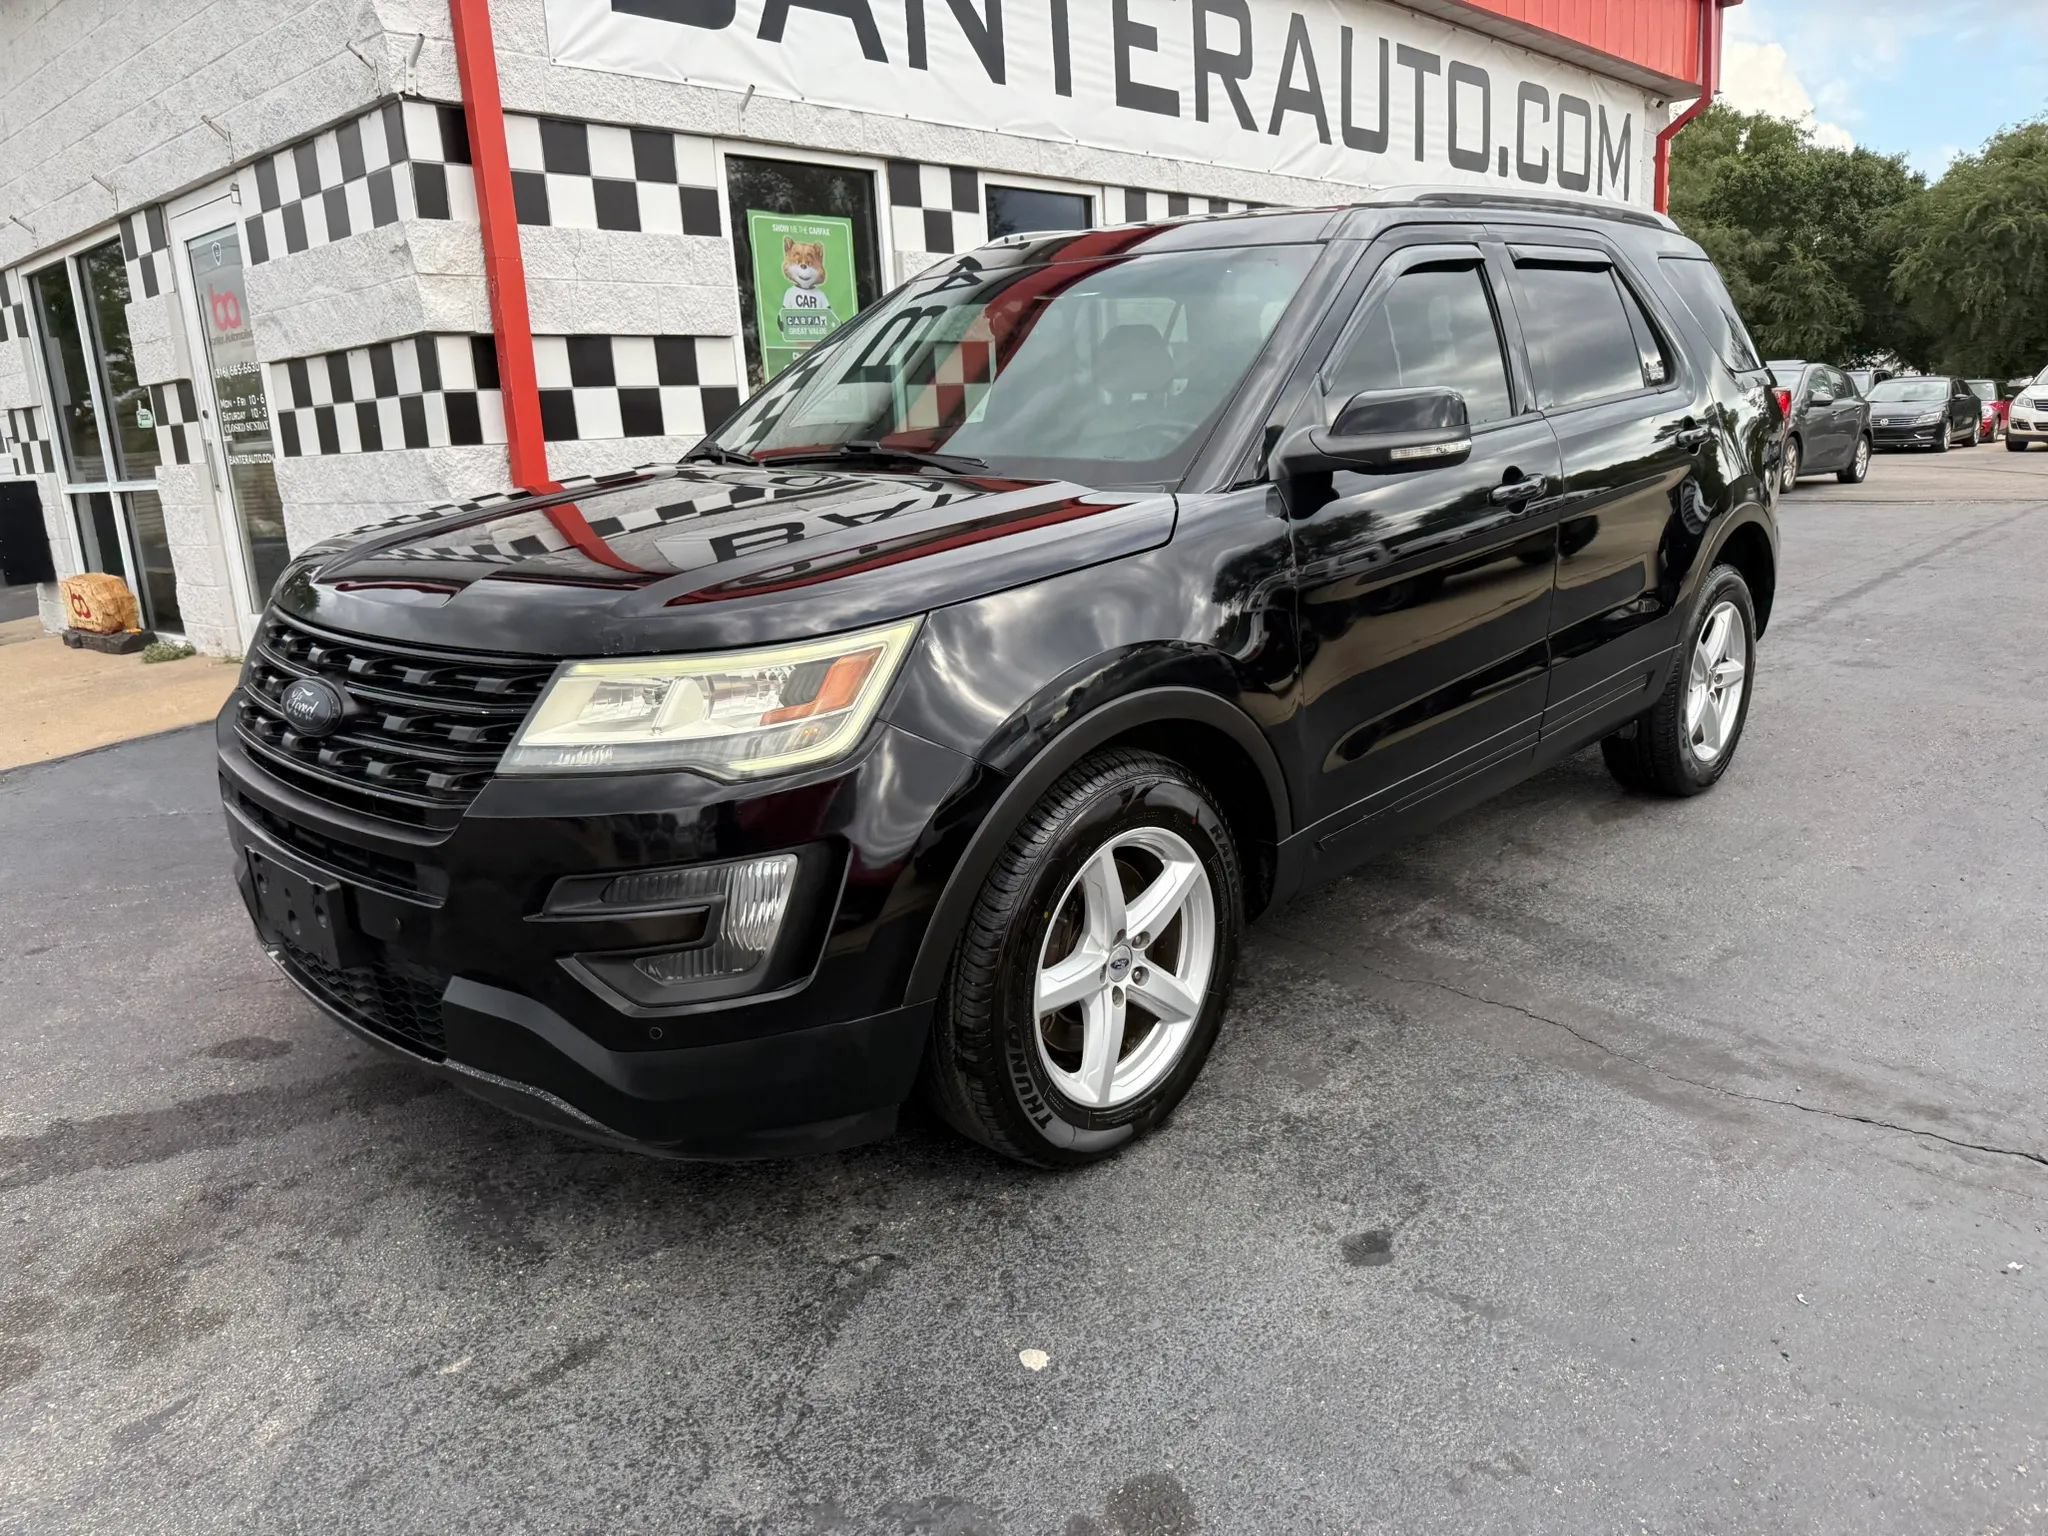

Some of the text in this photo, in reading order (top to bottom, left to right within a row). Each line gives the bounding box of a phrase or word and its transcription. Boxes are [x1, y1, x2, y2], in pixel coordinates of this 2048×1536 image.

[612, 0, 1632, 201] ERAUTO.COM
[795, 294, 818, 309] CAR
[786, 316, 828, 329] CARFAX
[286, 686, 320, 721] Ford
